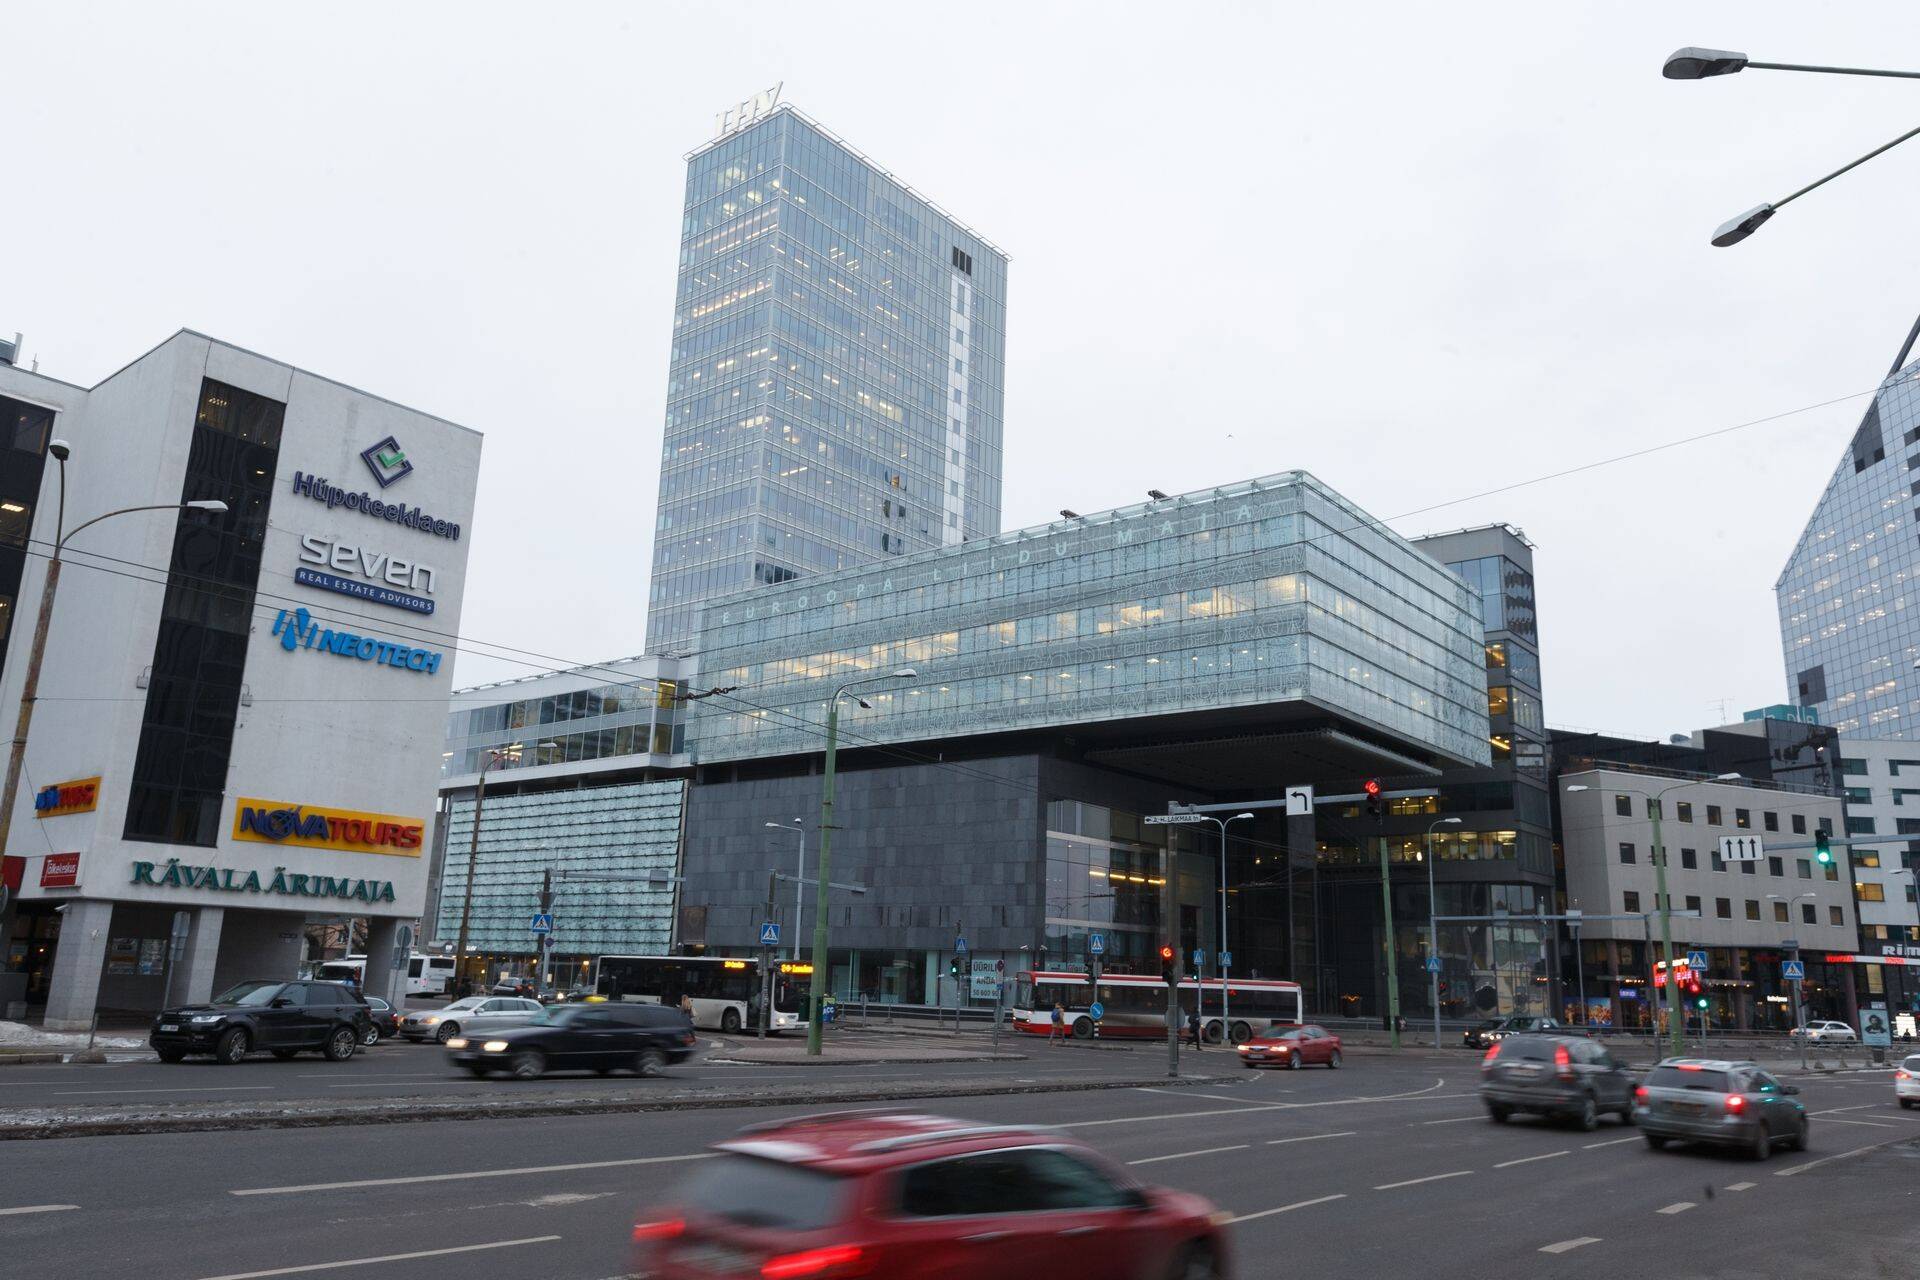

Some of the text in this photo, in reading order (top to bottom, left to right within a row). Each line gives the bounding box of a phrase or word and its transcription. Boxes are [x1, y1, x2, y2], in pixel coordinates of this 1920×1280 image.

[293, 470, 461, 541] Hüpoteeklaen
[722, 577, 892, 624] EUROPA
[933, 541, 1067, 581] LIIDU
[1117, 504, 1251, 544] MAJA
[299, 570, 433, 611] REAL ESTATE ADVISORS
[317, 628, 442, 674] NEOTECH
[240, 804, 422, 849] NOVATOURS
[130, 857, 396, 904] RÄVALA ÄRIMAJA
